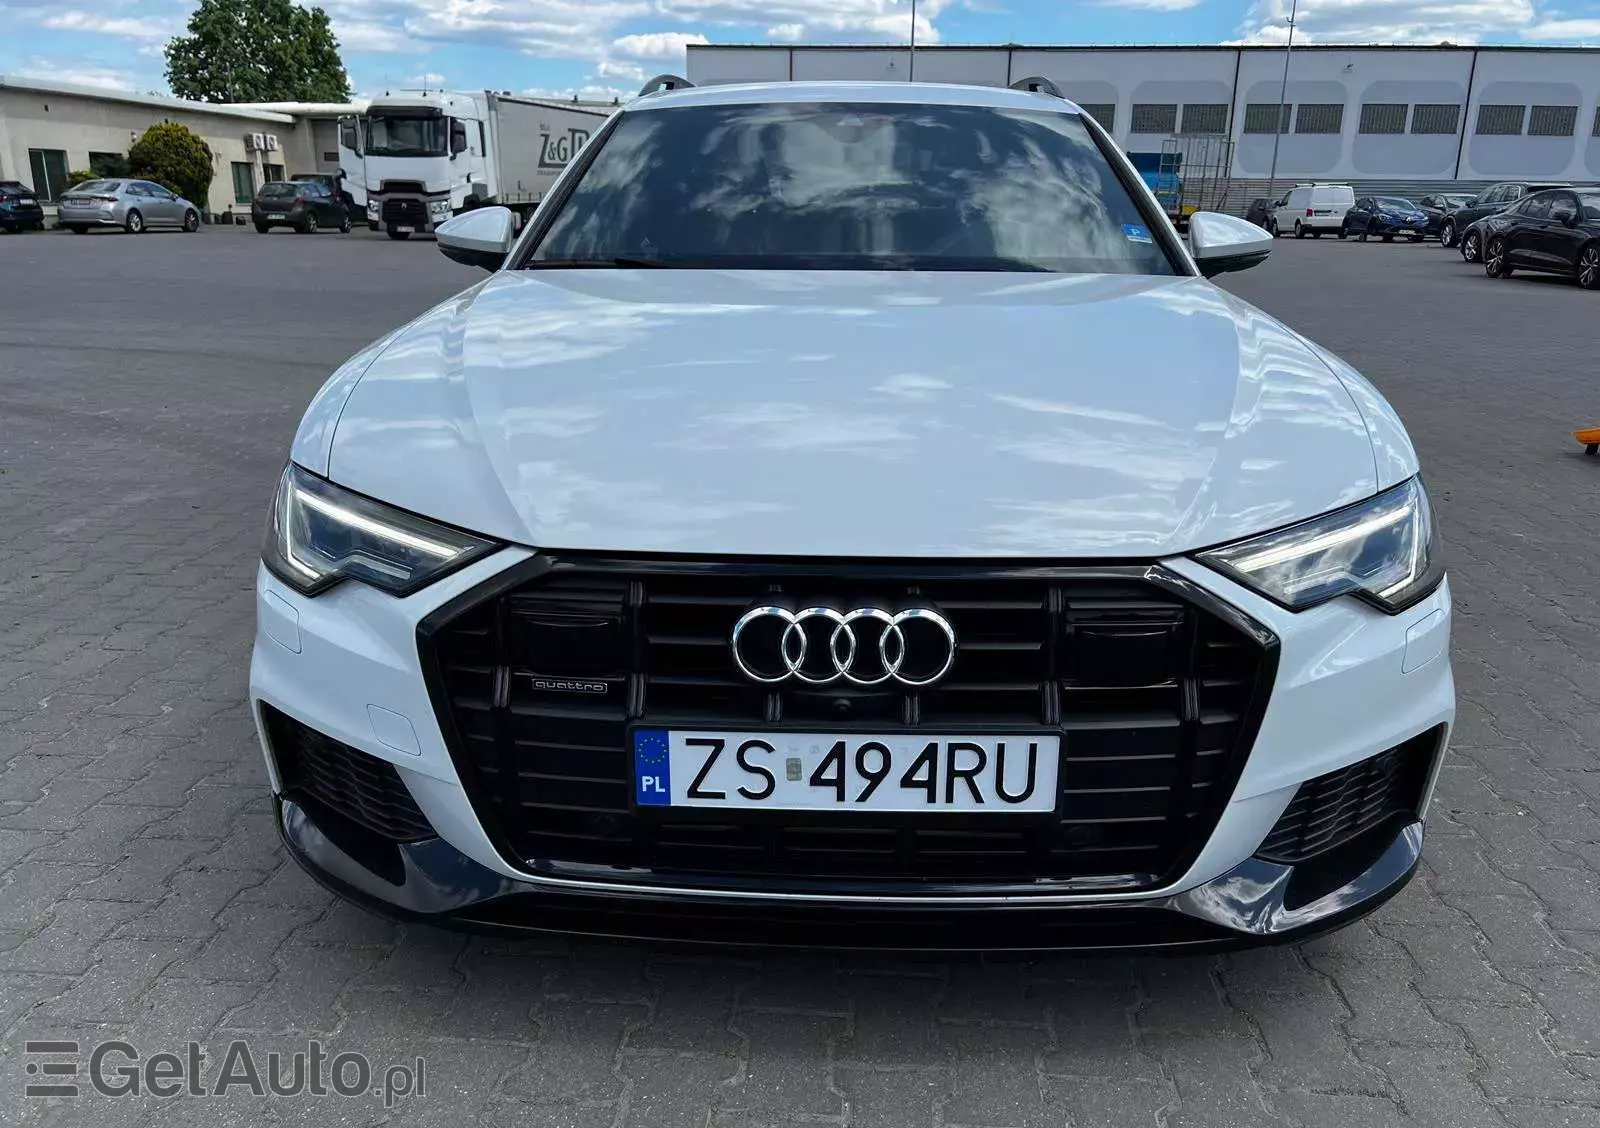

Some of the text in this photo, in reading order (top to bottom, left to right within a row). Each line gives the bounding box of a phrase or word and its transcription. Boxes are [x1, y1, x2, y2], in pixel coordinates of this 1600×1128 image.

[535, 681, 604, 691] quattro
[685, 738, 1038, 804] ZS 494RU
[641, 775, 666, 793] PL
